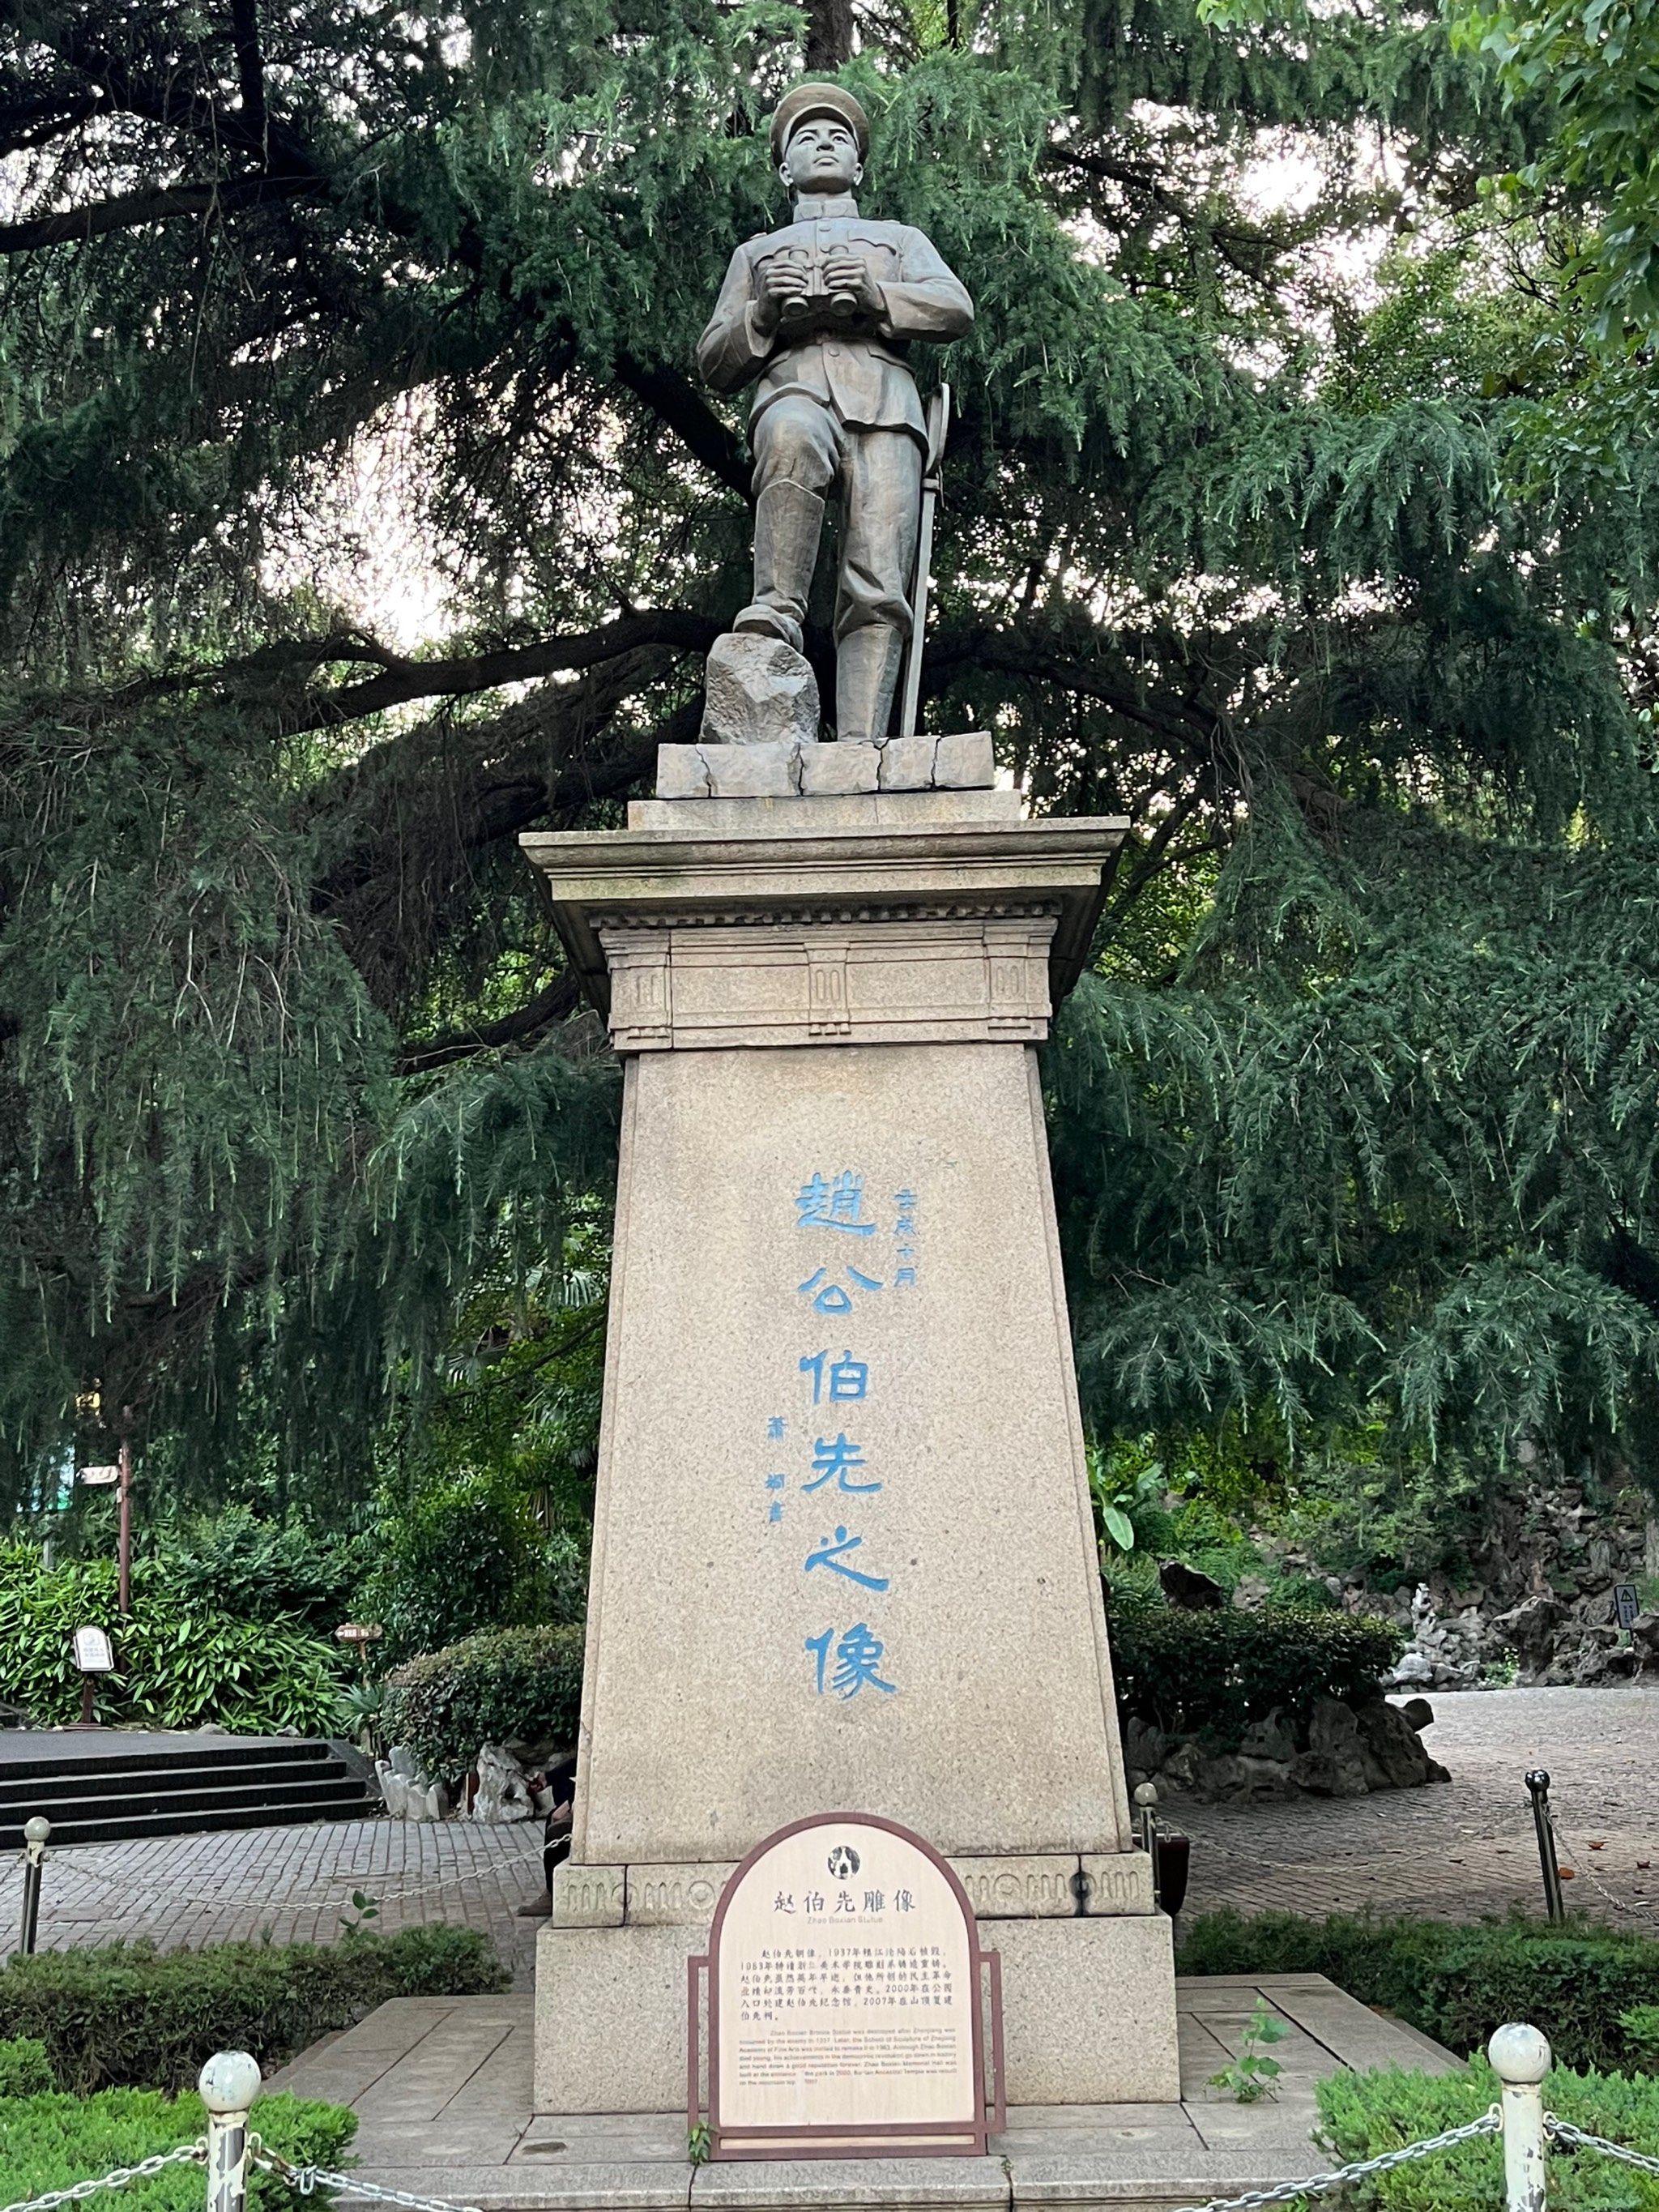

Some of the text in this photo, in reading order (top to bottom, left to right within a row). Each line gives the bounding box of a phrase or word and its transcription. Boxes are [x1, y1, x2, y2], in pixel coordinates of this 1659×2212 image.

[795, 1169, 896, 1702] 趙公伯先之像
[774, 1890, 916, 1915] 赵伯先雕像
[808, 1916, 827, 1924] Zhao
[829, 1916, 856, 1924] Boxian
